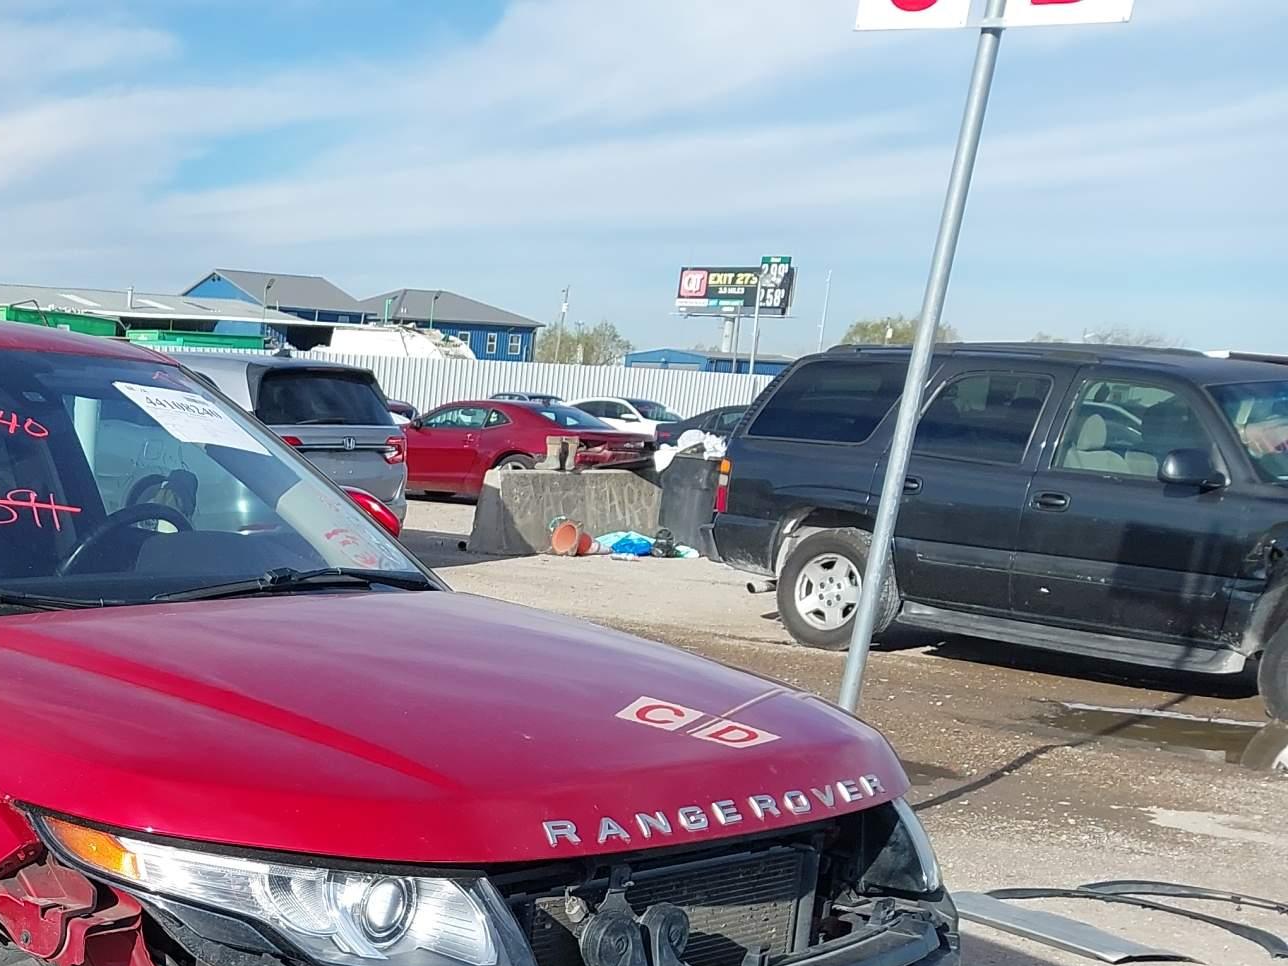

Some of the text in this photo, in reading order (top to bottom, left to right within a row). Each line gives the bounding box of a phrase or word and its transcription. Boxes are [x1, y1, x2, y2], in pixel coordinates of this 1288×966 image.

[708, 273, 735, 285] EXIT
[542, 773, 886, 848] RANGE ROVER
